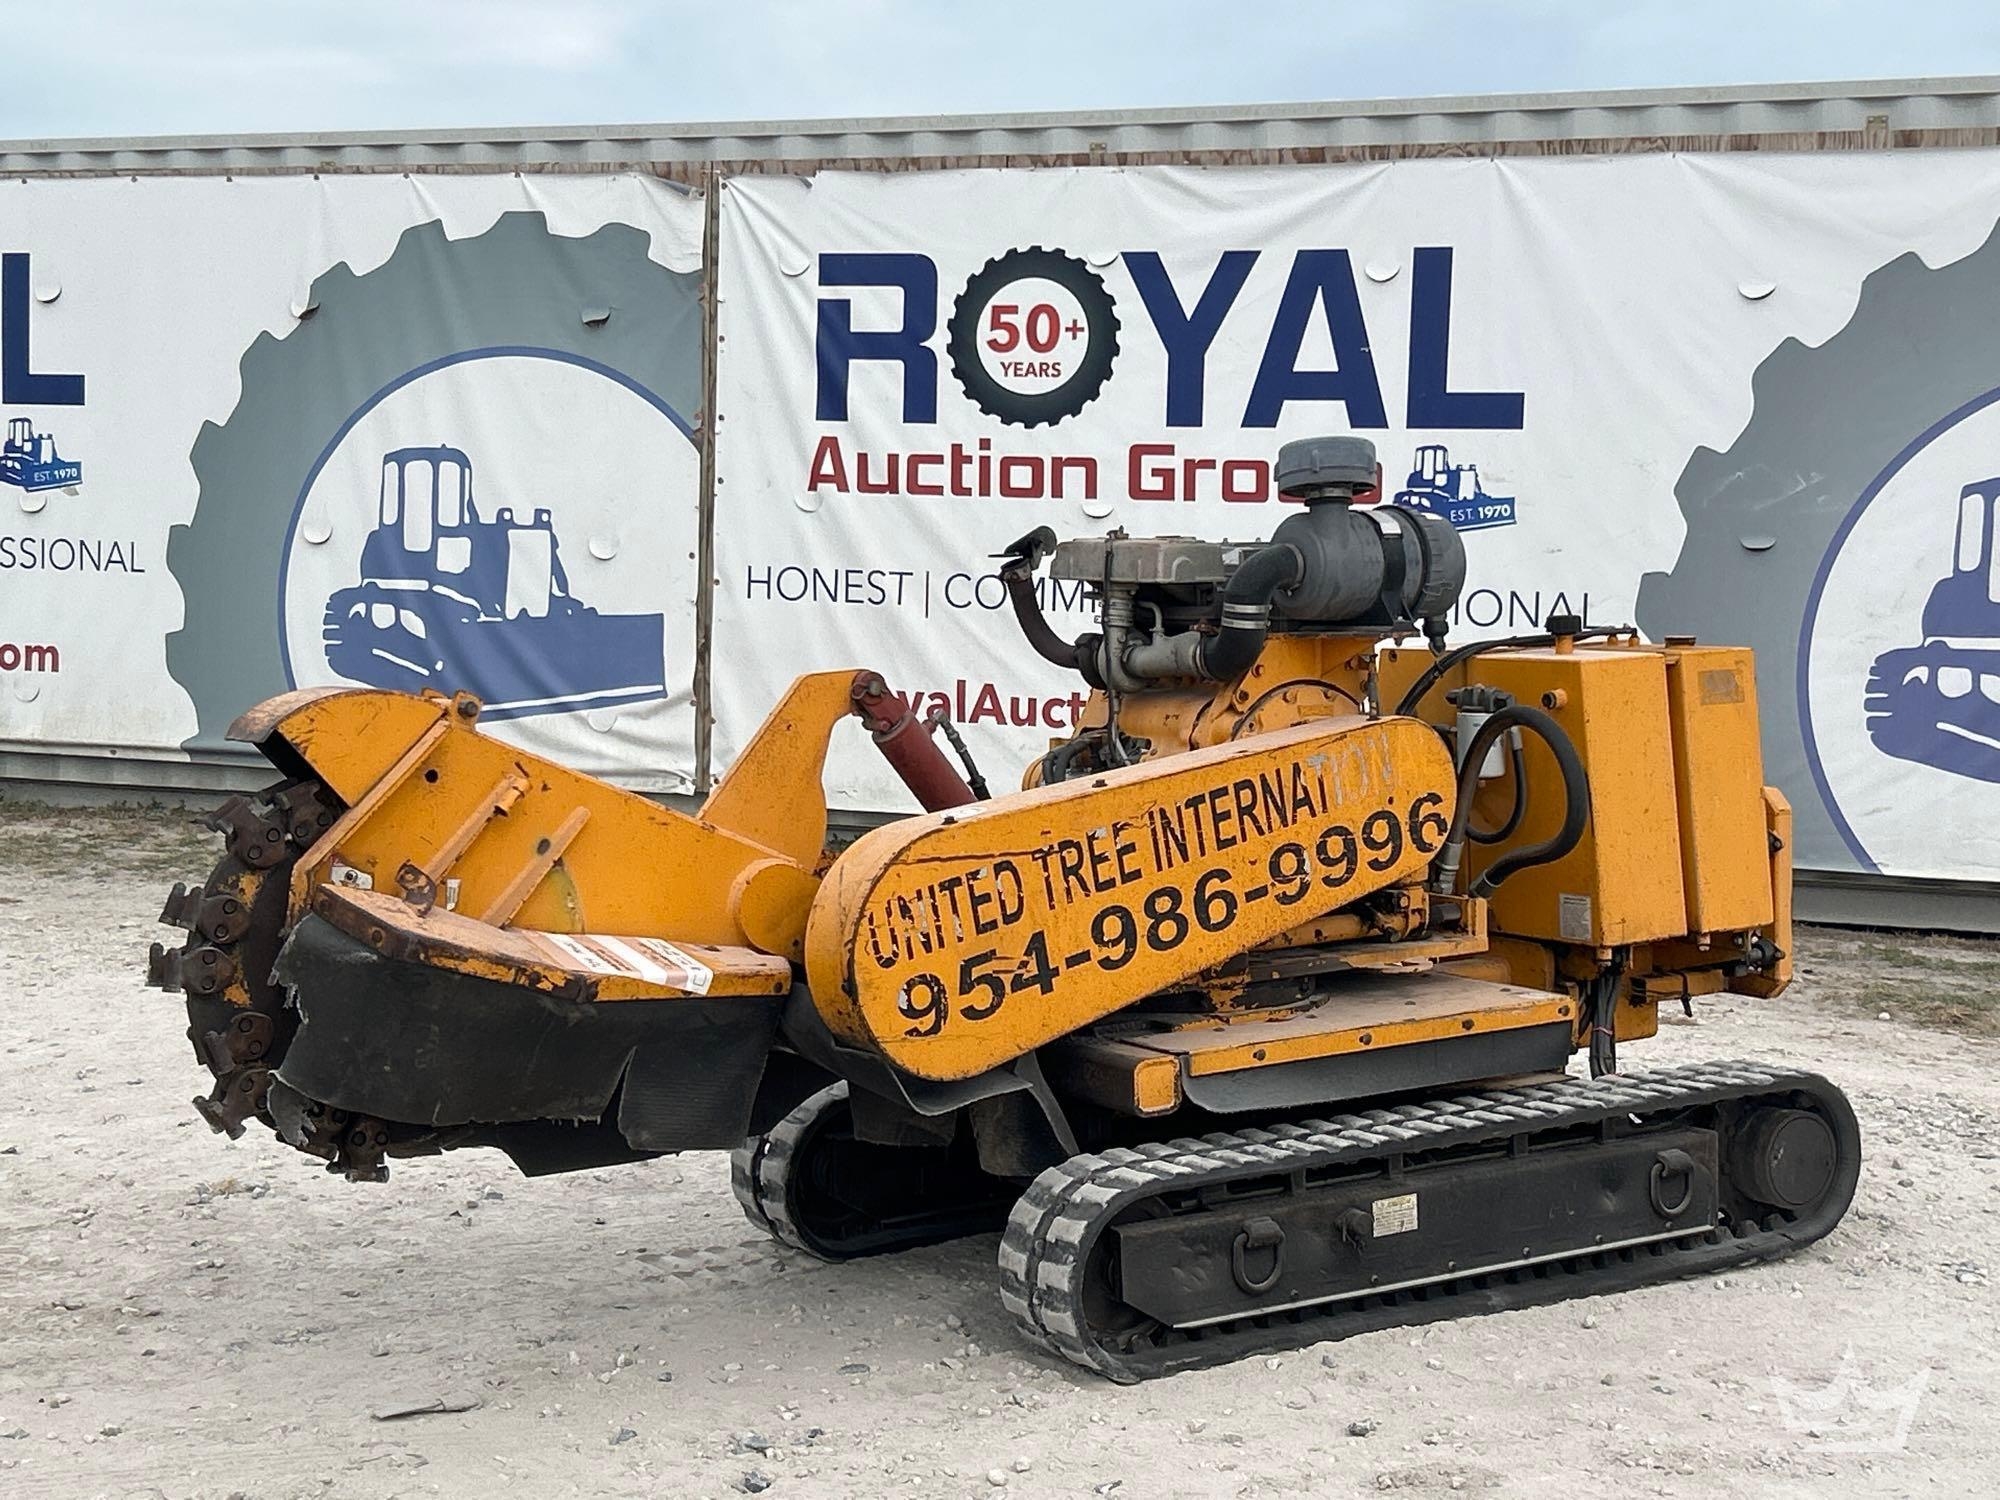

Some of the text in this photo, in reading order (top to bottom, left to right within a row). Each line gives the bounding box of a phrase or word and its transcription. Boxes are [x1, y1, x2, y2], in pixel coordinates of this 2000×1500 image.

[986, 303, 1086, 354] 50+
[1000, 361, 1063, 379] YEARS
[53, 467, 78, 480] 1970
[807, 436, 1383, 505] Auction Gro
[1449, 504, 1511, 522] EST. 1970
[746, 565, 914, 606] HONEST
[867, 859, 1025, 969] UNITED
[1031, 820, 1143, 911] TREE
[896, 792, 1450, 1038] 954-986-9996
